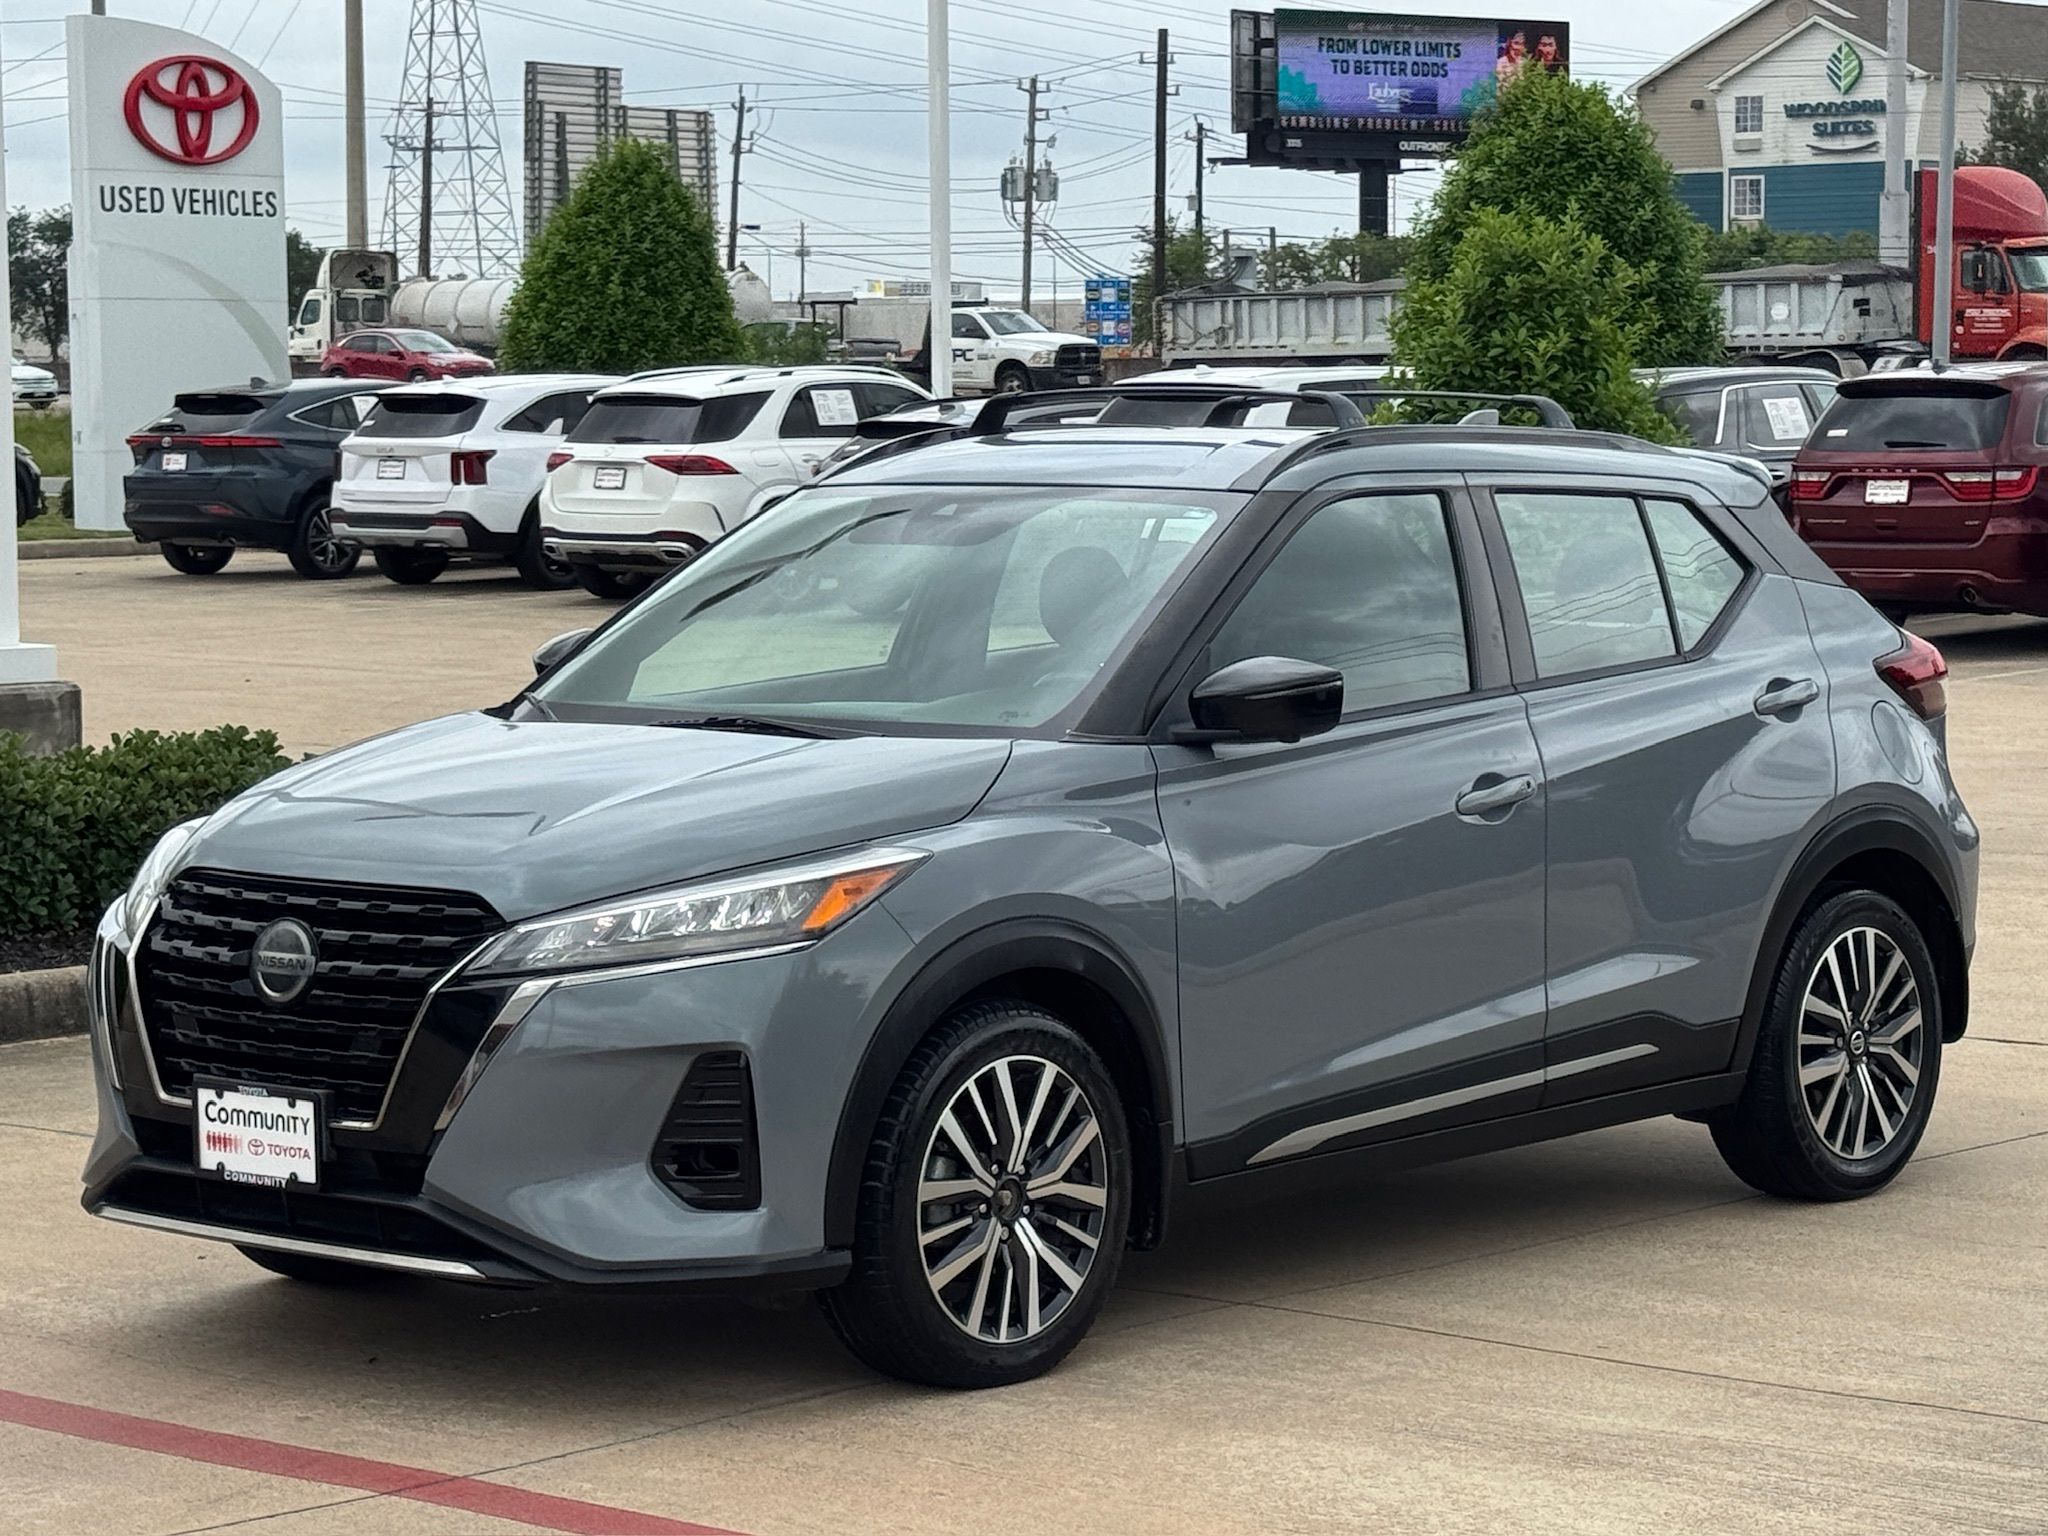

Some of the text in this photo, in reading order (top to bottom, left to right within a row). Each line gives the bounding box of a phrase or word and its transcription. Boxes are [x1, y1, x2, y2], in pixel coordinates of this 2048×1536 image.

[1318, 37, 1462, 58] FROM LOWER LIMITS
[1331, 59, 1449, 78] TO BETTER ODDS
[1812, 120, 1875, 137] SUITES
[100, 185, 278, 218] USED VEHICLES
[257, 955, 307, 970] NISSAN
[267, 1144, 312, 1160] TOYOTA
[224, 1170, 288, 1188] COMMUNITY
